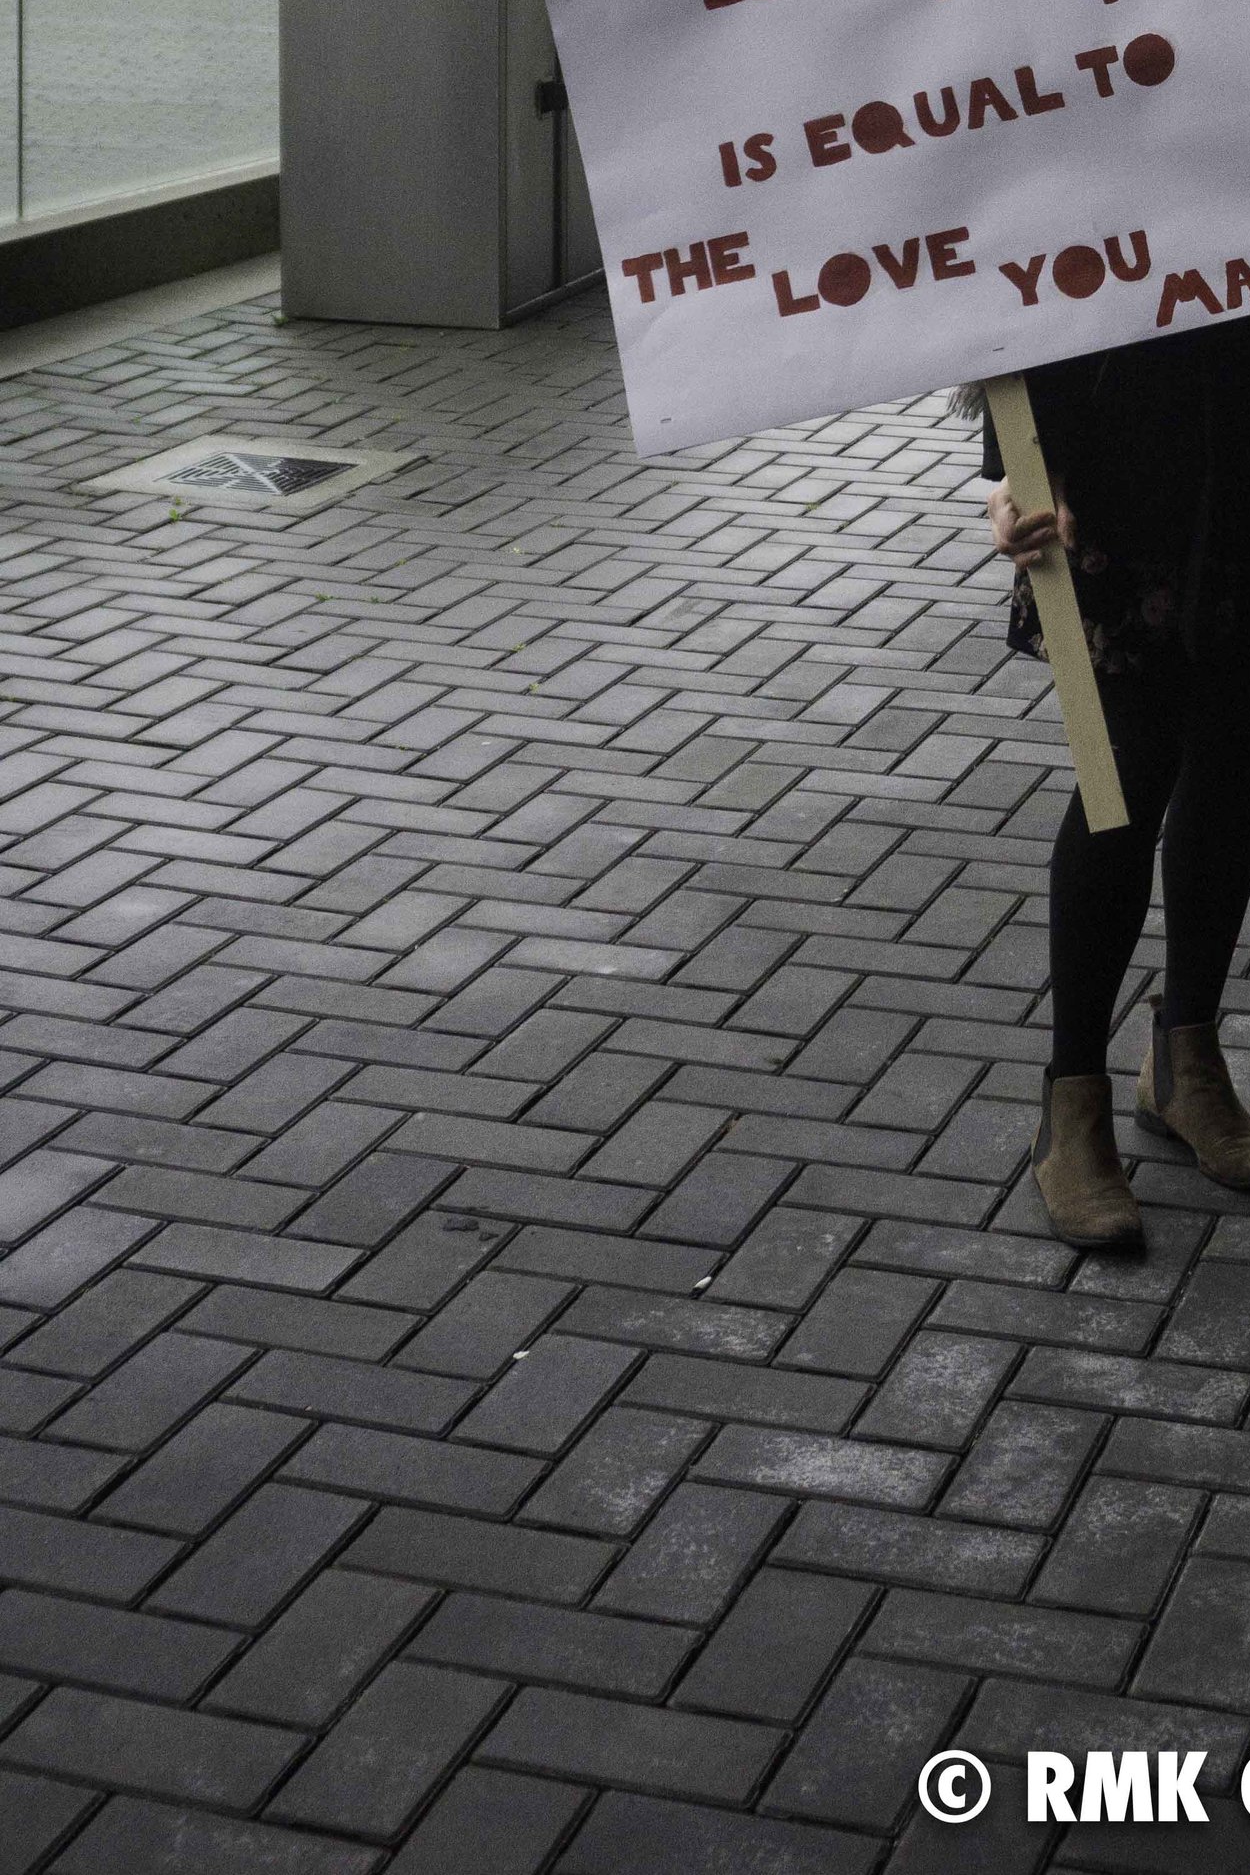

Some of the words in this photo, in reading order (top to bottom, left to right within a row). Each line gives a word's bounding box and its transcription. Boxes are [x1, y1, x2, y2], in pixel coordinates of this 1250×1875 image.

[718, 133, 776, 188] IS
[804, 65, 1065, 167] EQUAL
[1075, 33, 1176, 99] TO
[622, 231, 755, 304] THE
[771, 226, 977, 318] LOVE
[999, 230, 1151, 306] YOU
